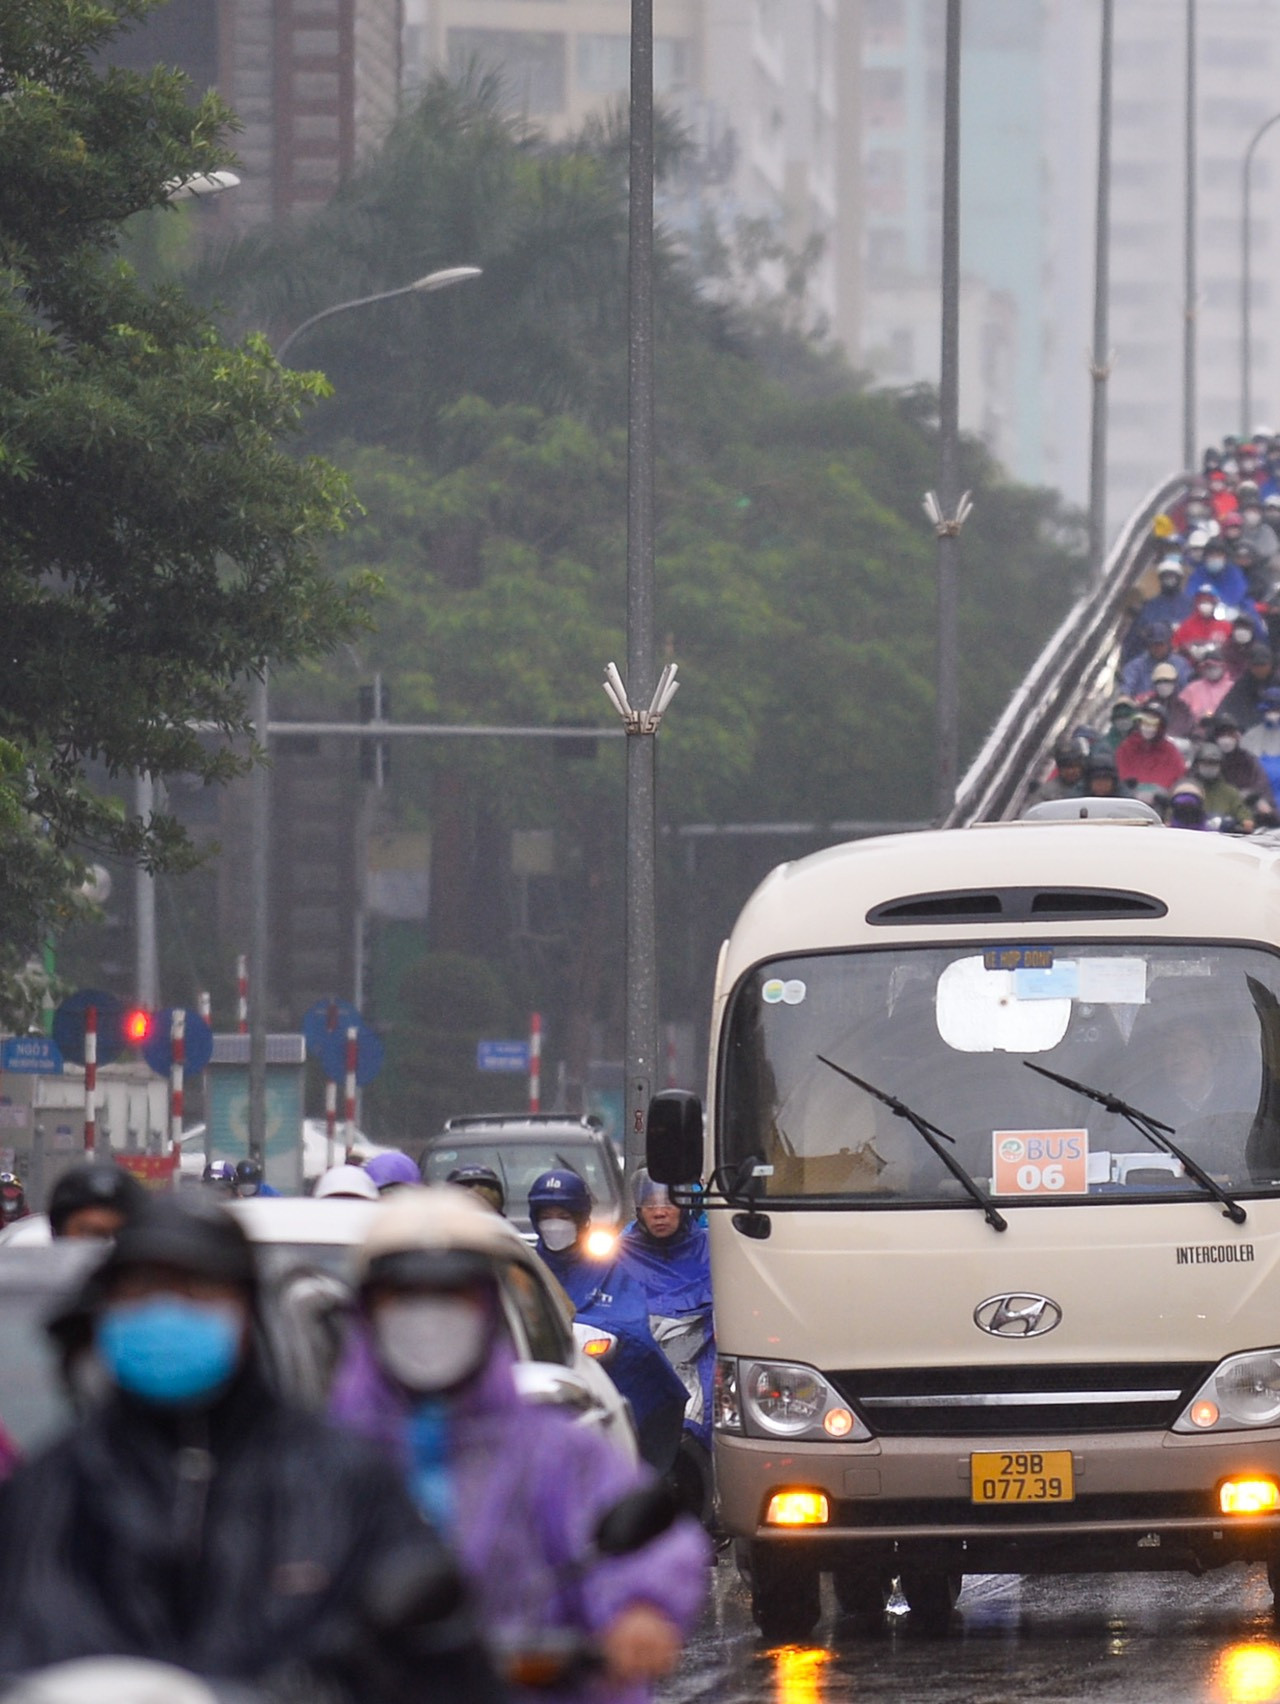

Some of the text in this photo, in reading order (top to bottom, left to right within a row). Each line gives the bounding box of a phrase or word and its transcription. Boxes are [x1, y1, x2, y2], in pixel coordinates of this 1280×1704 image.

[1027, 1138, 1081, 1160] BUS
[1017, 1164, 1065, 1191] 06
[1176, 1244, 1255, 1265] INTERCOOLER
[1000, 1454, 1044, 1475] 29B
[983, 1477, 1062, 1499] 077.39
